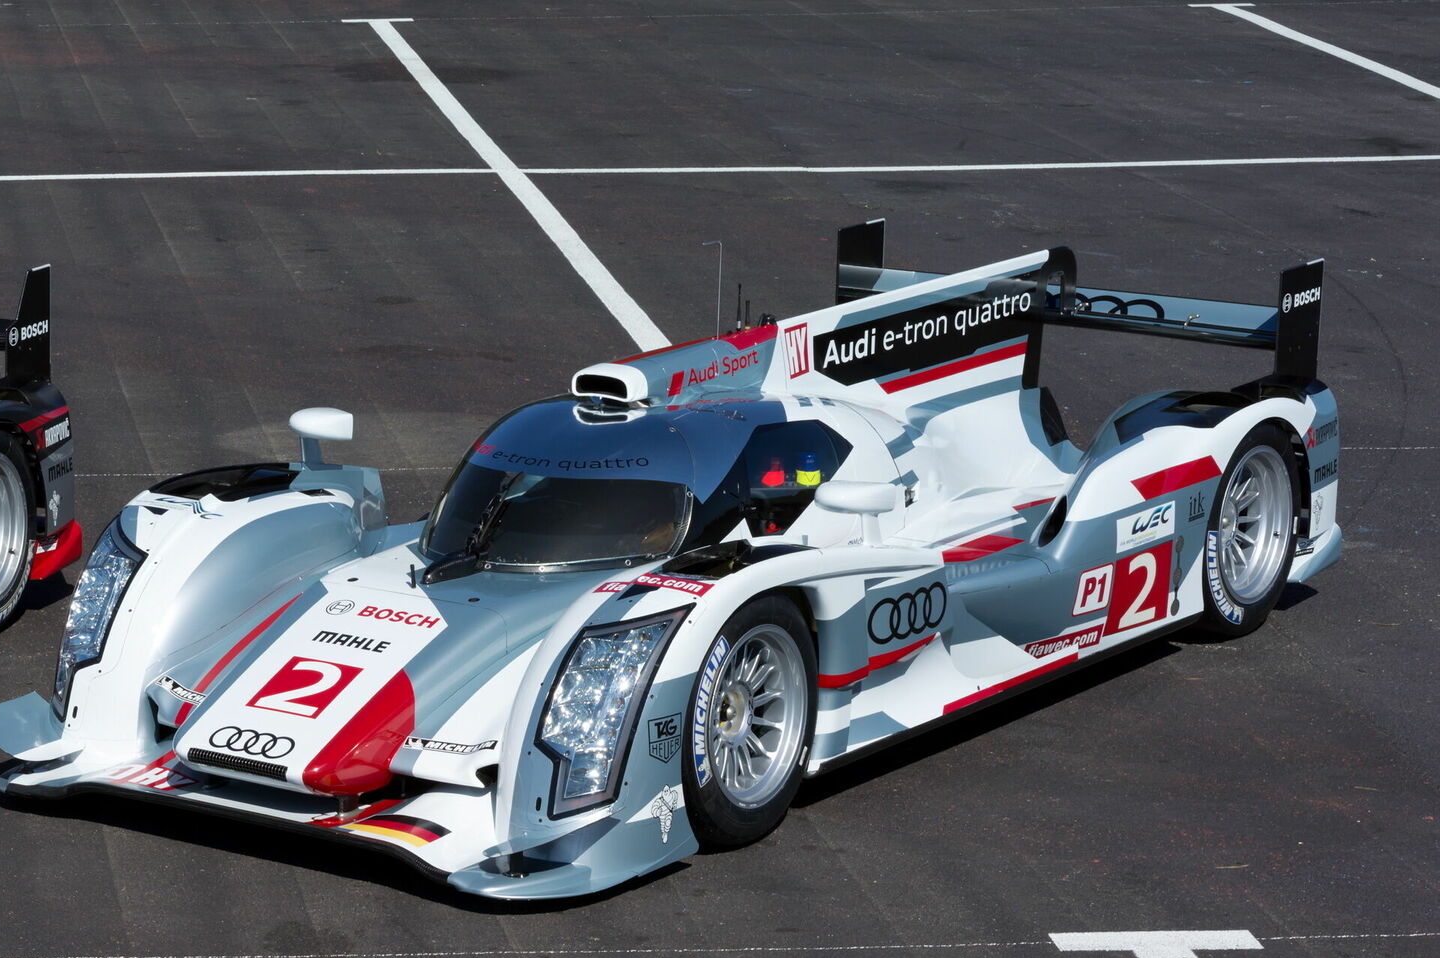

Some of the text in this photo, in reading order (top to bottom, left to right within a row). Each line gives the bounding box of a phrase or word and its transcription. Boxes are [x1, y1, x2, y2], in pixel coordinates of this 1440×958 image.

[1293, 286, 1321, 308] BOSCH
[20, 319, 49, 341] BOSCH
[822, 291, 1031, 369] Audi e-tron quattro
[785, 326, 807, 375] HY
[687, 350, 759, 387] Audi Sport
[48, 457, 74, 483] MAHLE
[492, 450, 551, 468] e-tron
[557, 457, 649, 472] quattro
[1314, 459, 1338, 485] MAHLE
[1131, 504, 1173, 535] WEC
[1208, 533, 1234, 618] MICHELIN
[1079, 572, 1108, 608] P1
[1117, 552, 1157, 630] 2
[356, 605, 440, 629] BOSCH
[312, 630, 391, 653] MAHLE
[253, 660, 343, 717] 2
[694, 639, 727, 756] MICHELIN
[654, 720, 678, 737] TAG
[424, 740, 495, 753] MICHELIN
[651, 738, 681, 762] HEUER
